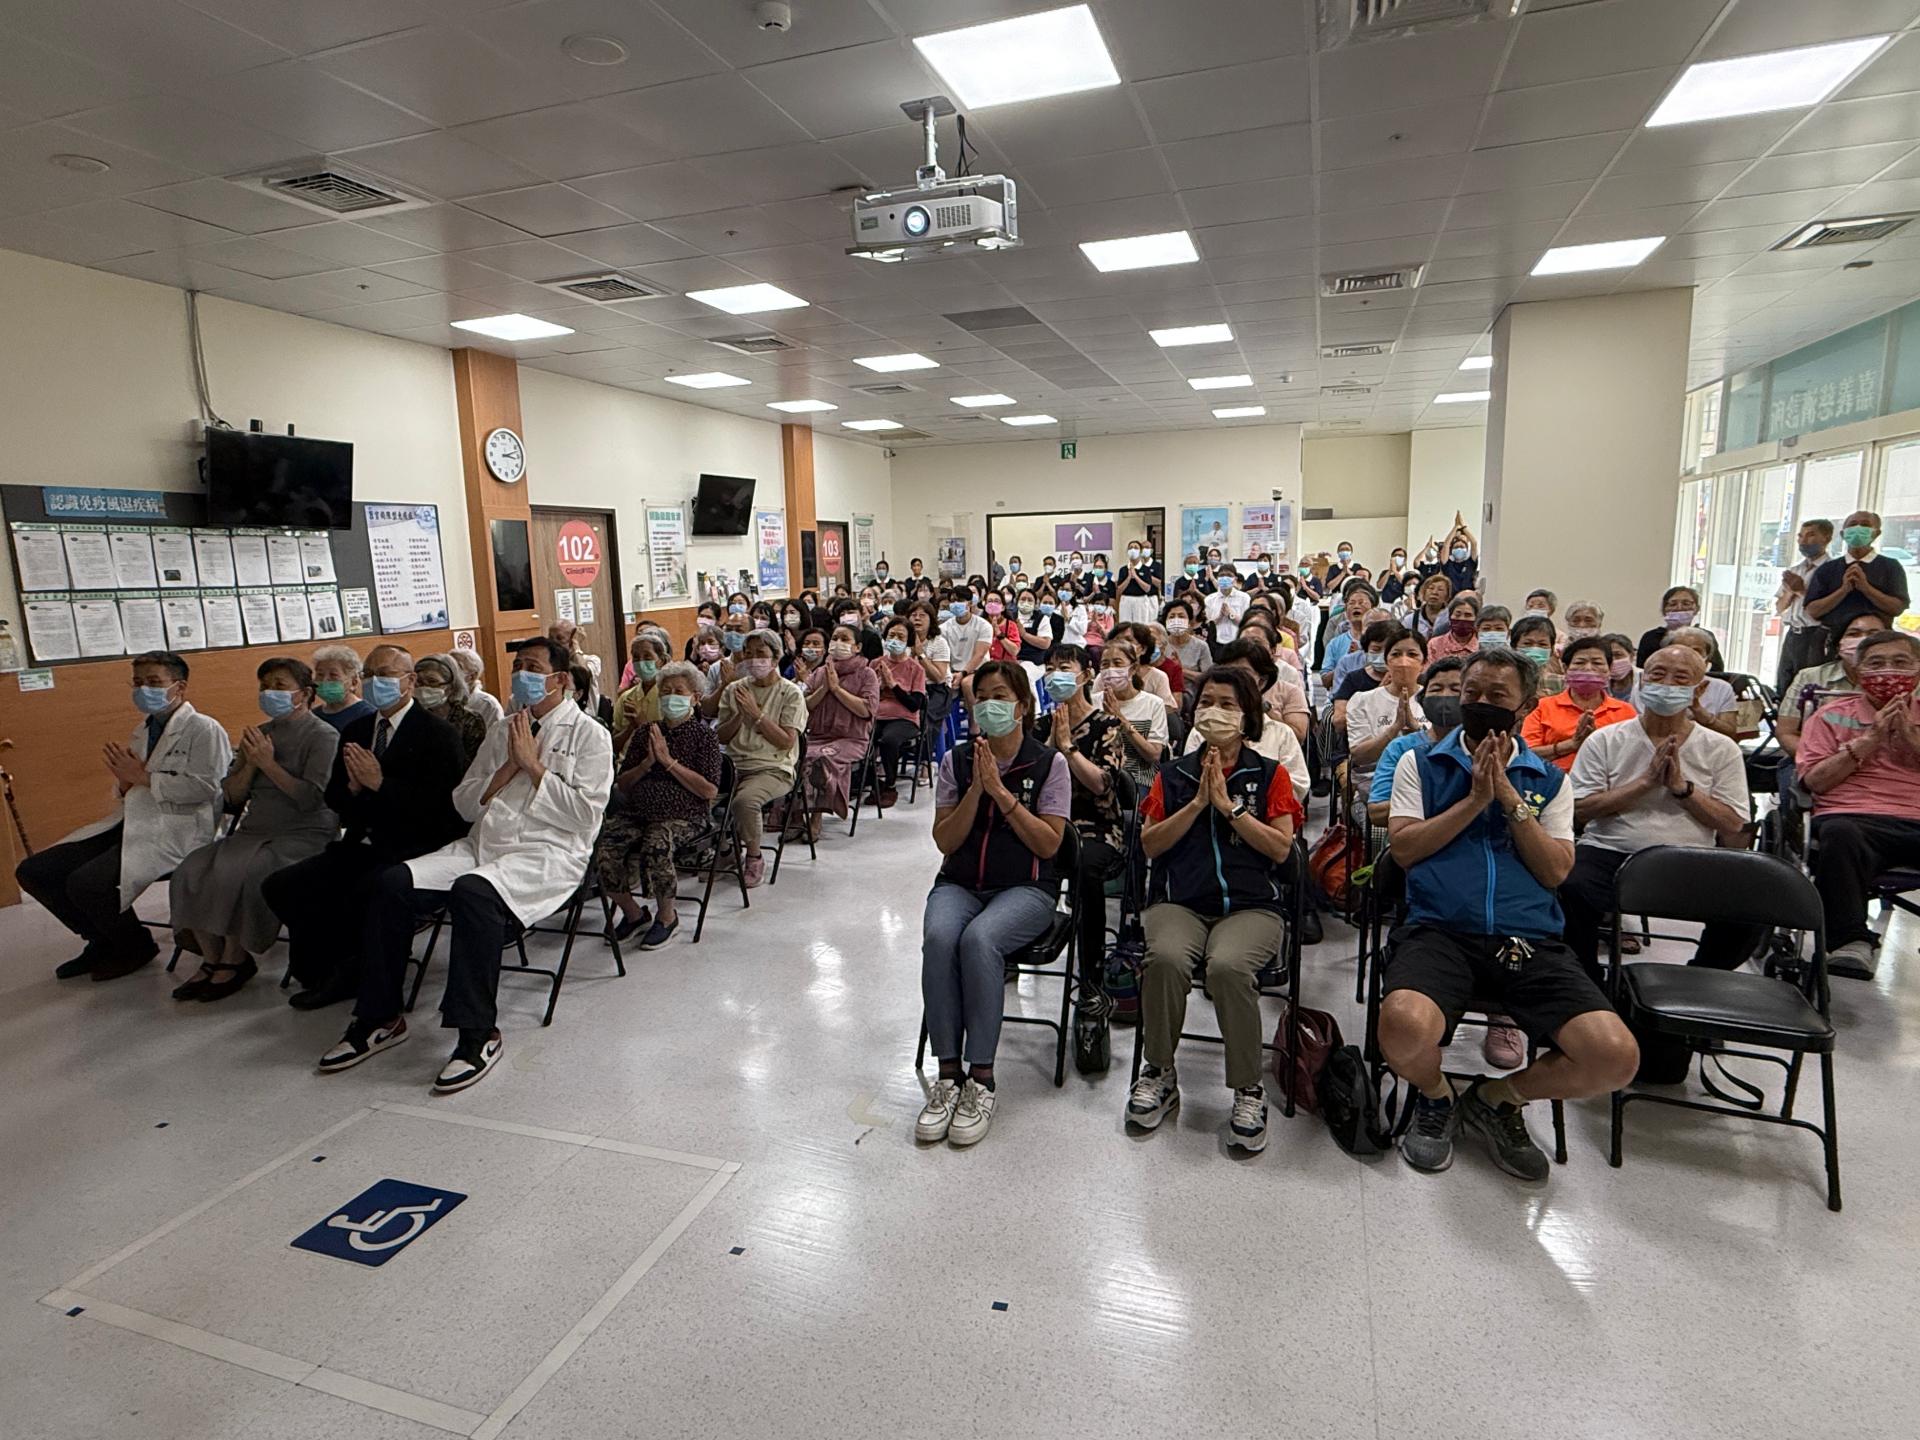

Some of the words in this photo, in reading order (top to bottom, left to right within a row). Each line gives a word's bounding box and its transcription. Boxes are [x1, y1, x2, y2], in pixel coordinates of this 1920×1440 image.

[49, 494, 159, 513] 認識免疫風濕疾病
[559, 535, 595, 561] 102
[823, 539, 839, 557] 103
[1058, 554, 1068, 563] 4F
[1377, 715, 1393, 727] The
